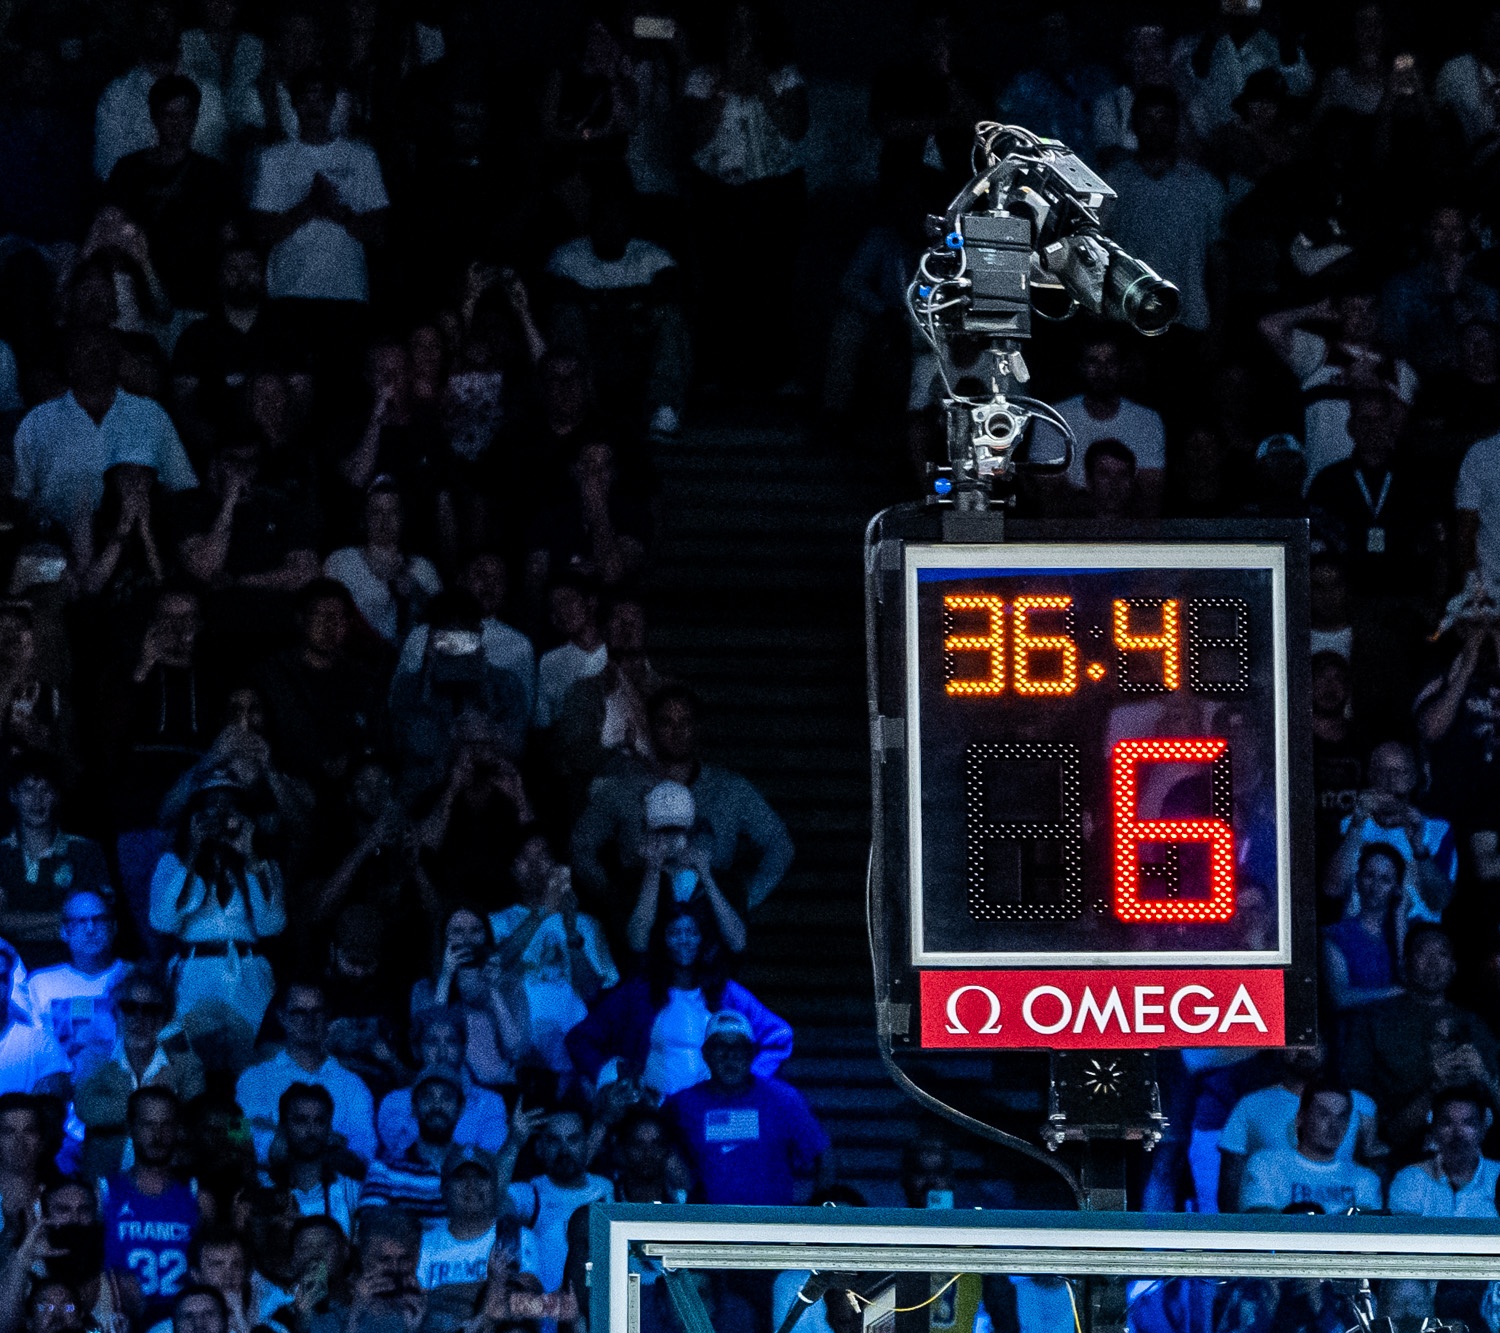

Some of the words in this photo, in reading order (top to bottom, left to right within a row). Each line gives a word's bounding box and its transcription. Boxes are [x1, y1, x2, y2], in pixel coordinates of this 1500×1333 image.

[943, 594, 1180, 696] 36.4
[1111, 738, 1235, 923] 6
[1022, 984, 1267, 1034] OMEGA
[117, 1222, 188, 1243] FRANCE
[128, 1250, 186, 1297] 32
